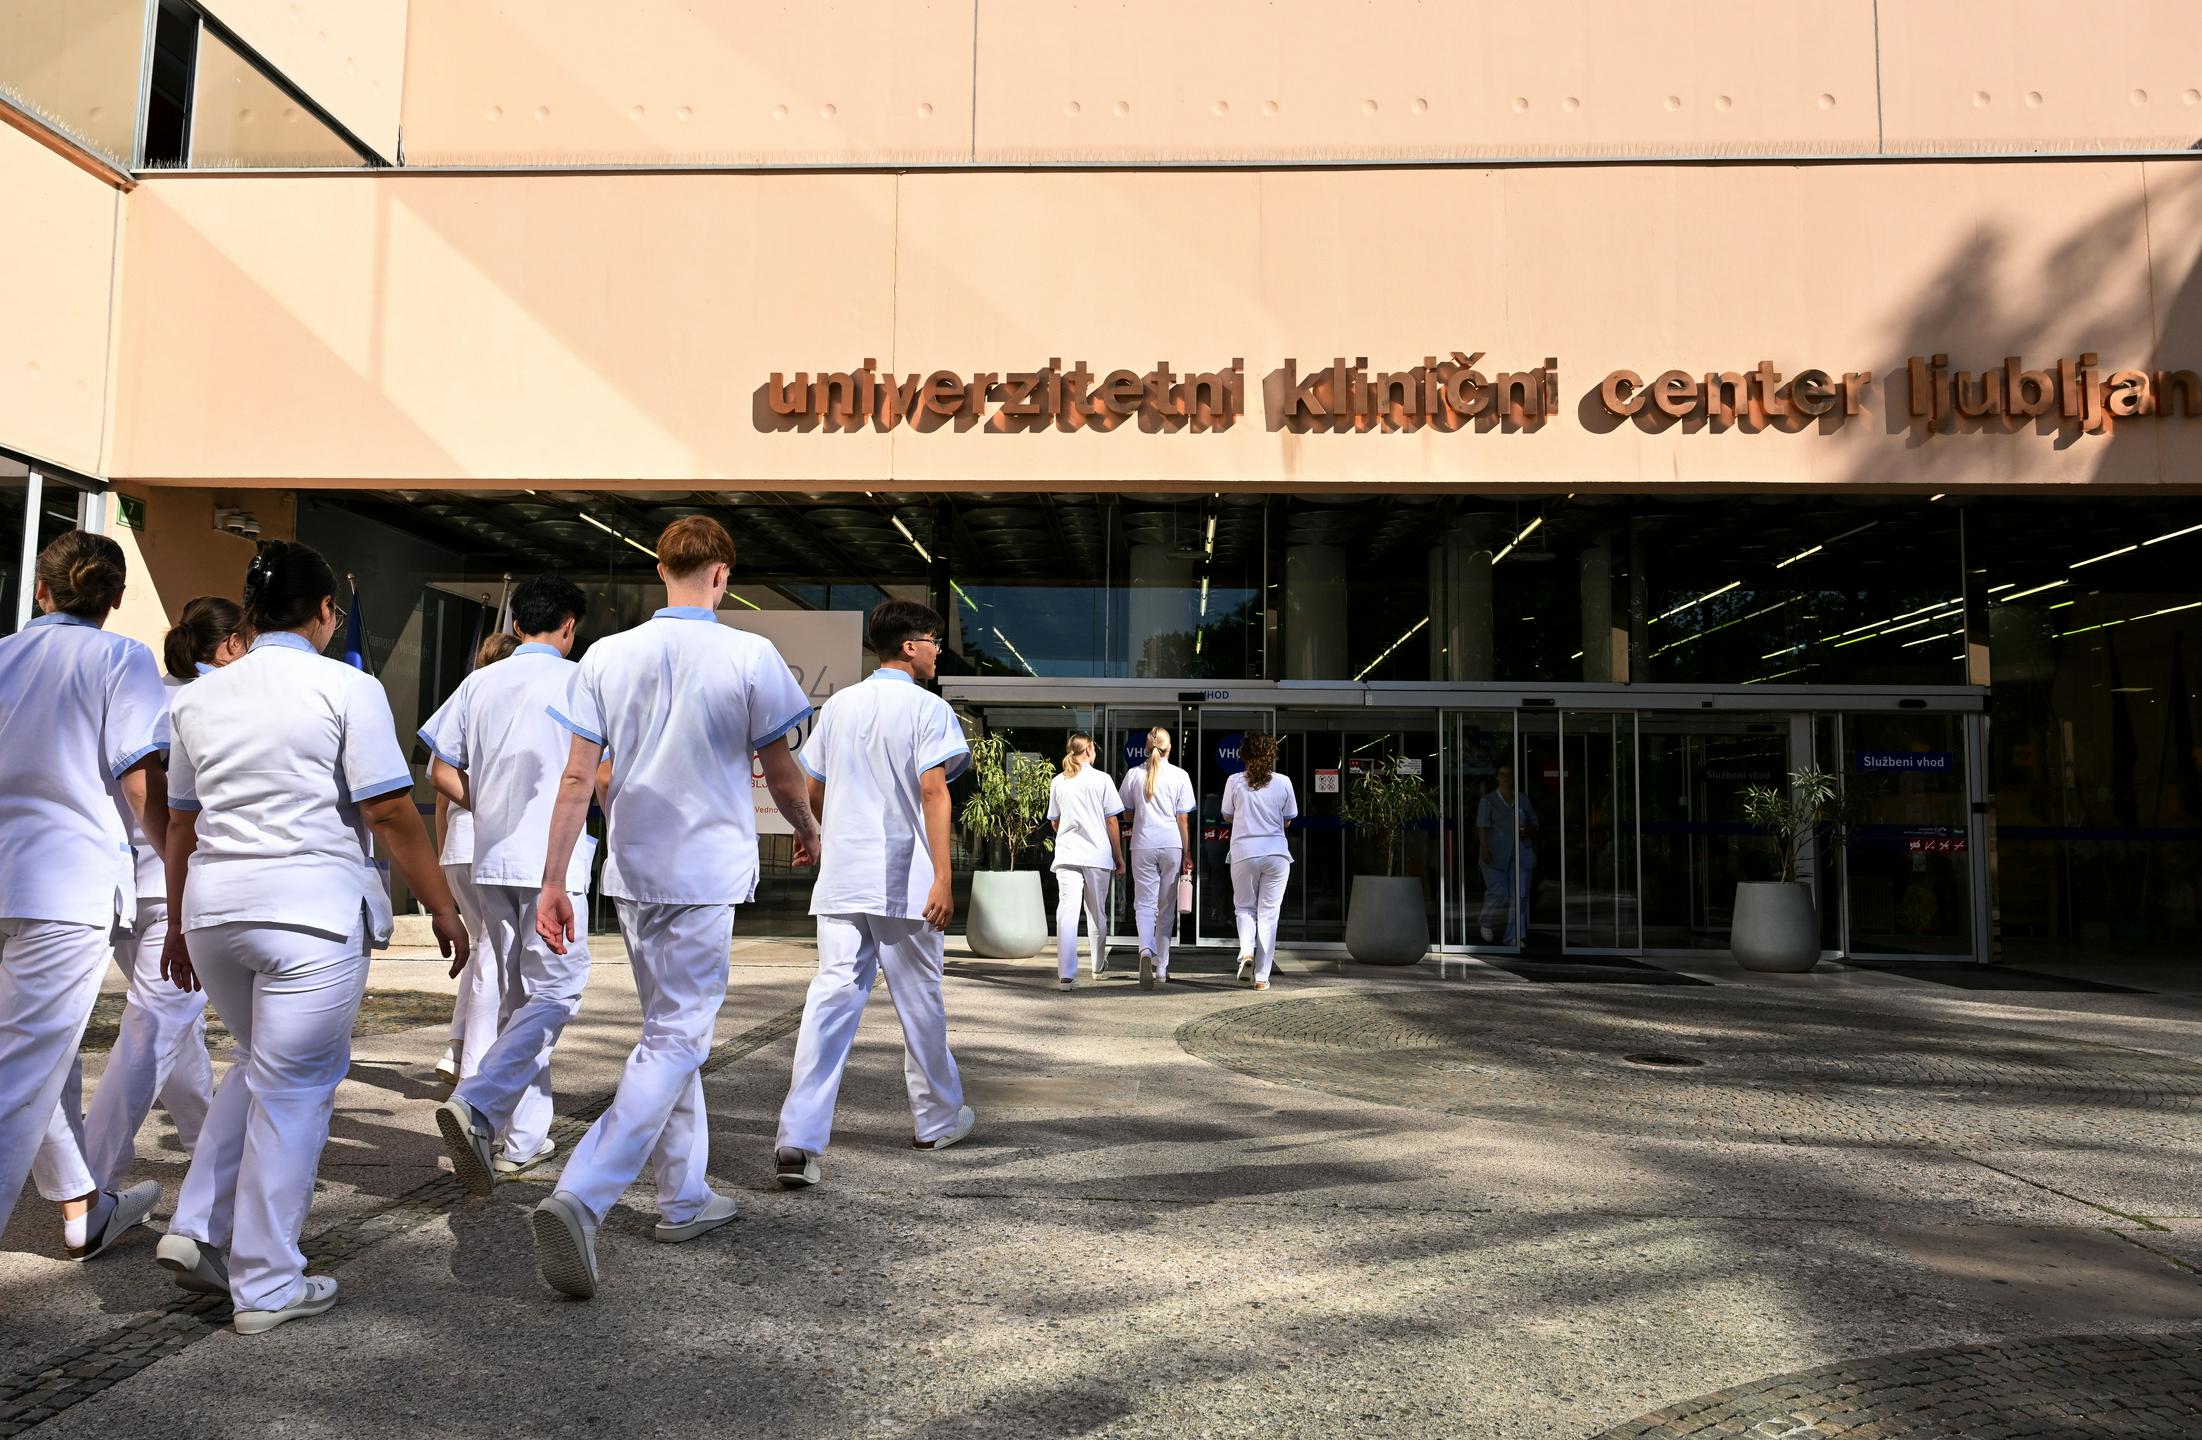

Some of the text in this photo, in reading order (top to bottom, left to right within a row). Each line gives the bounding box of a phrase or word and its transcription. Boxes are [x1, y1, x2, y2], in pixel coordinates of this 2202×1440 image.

[767, 357, 1244, 416] univerzitetni
[1284, 352, 1558, 415] klinični
[1602, 361, 1871, 416] center
[1863, 756, 1945, 767] Službeni vhod
[755, 806, 779, 814] Vedno
